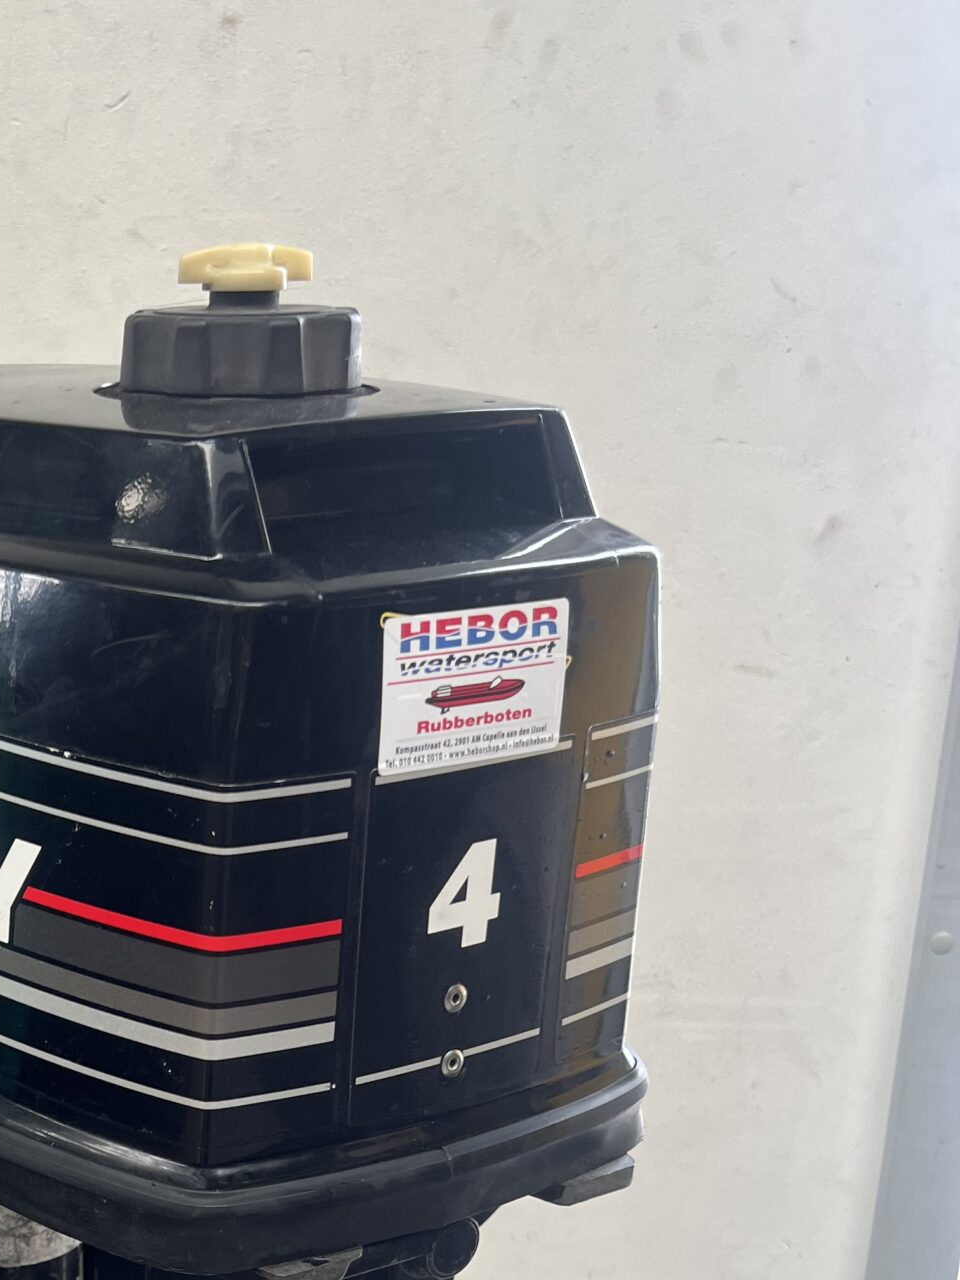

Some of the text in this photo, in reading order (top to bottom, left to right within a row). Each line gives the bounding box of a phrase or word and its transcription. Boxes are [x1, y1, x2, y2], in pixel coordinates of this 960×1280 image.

[400, 606, 558, 653] HEBOR
[400, 641, 557, 676] watersport
[416, 707, 532, 734] Rubberboten
[395, 741, 441, 755] Kompasstraat
[443, 739, 453, 748] 42,
[454, 736, 470, 746] 2901
[471, 734, 481, 744] AM
[482, 731, 505, 742] Capelle
[506, 729, 517, 738] aan
[519, 726, 530, 735] den
[385, 759, 397, 769] Tel.
[399, 758, 412, 767] 010
[413, 755, 425, 764] 442
[427, 838, 501, 948] 4
